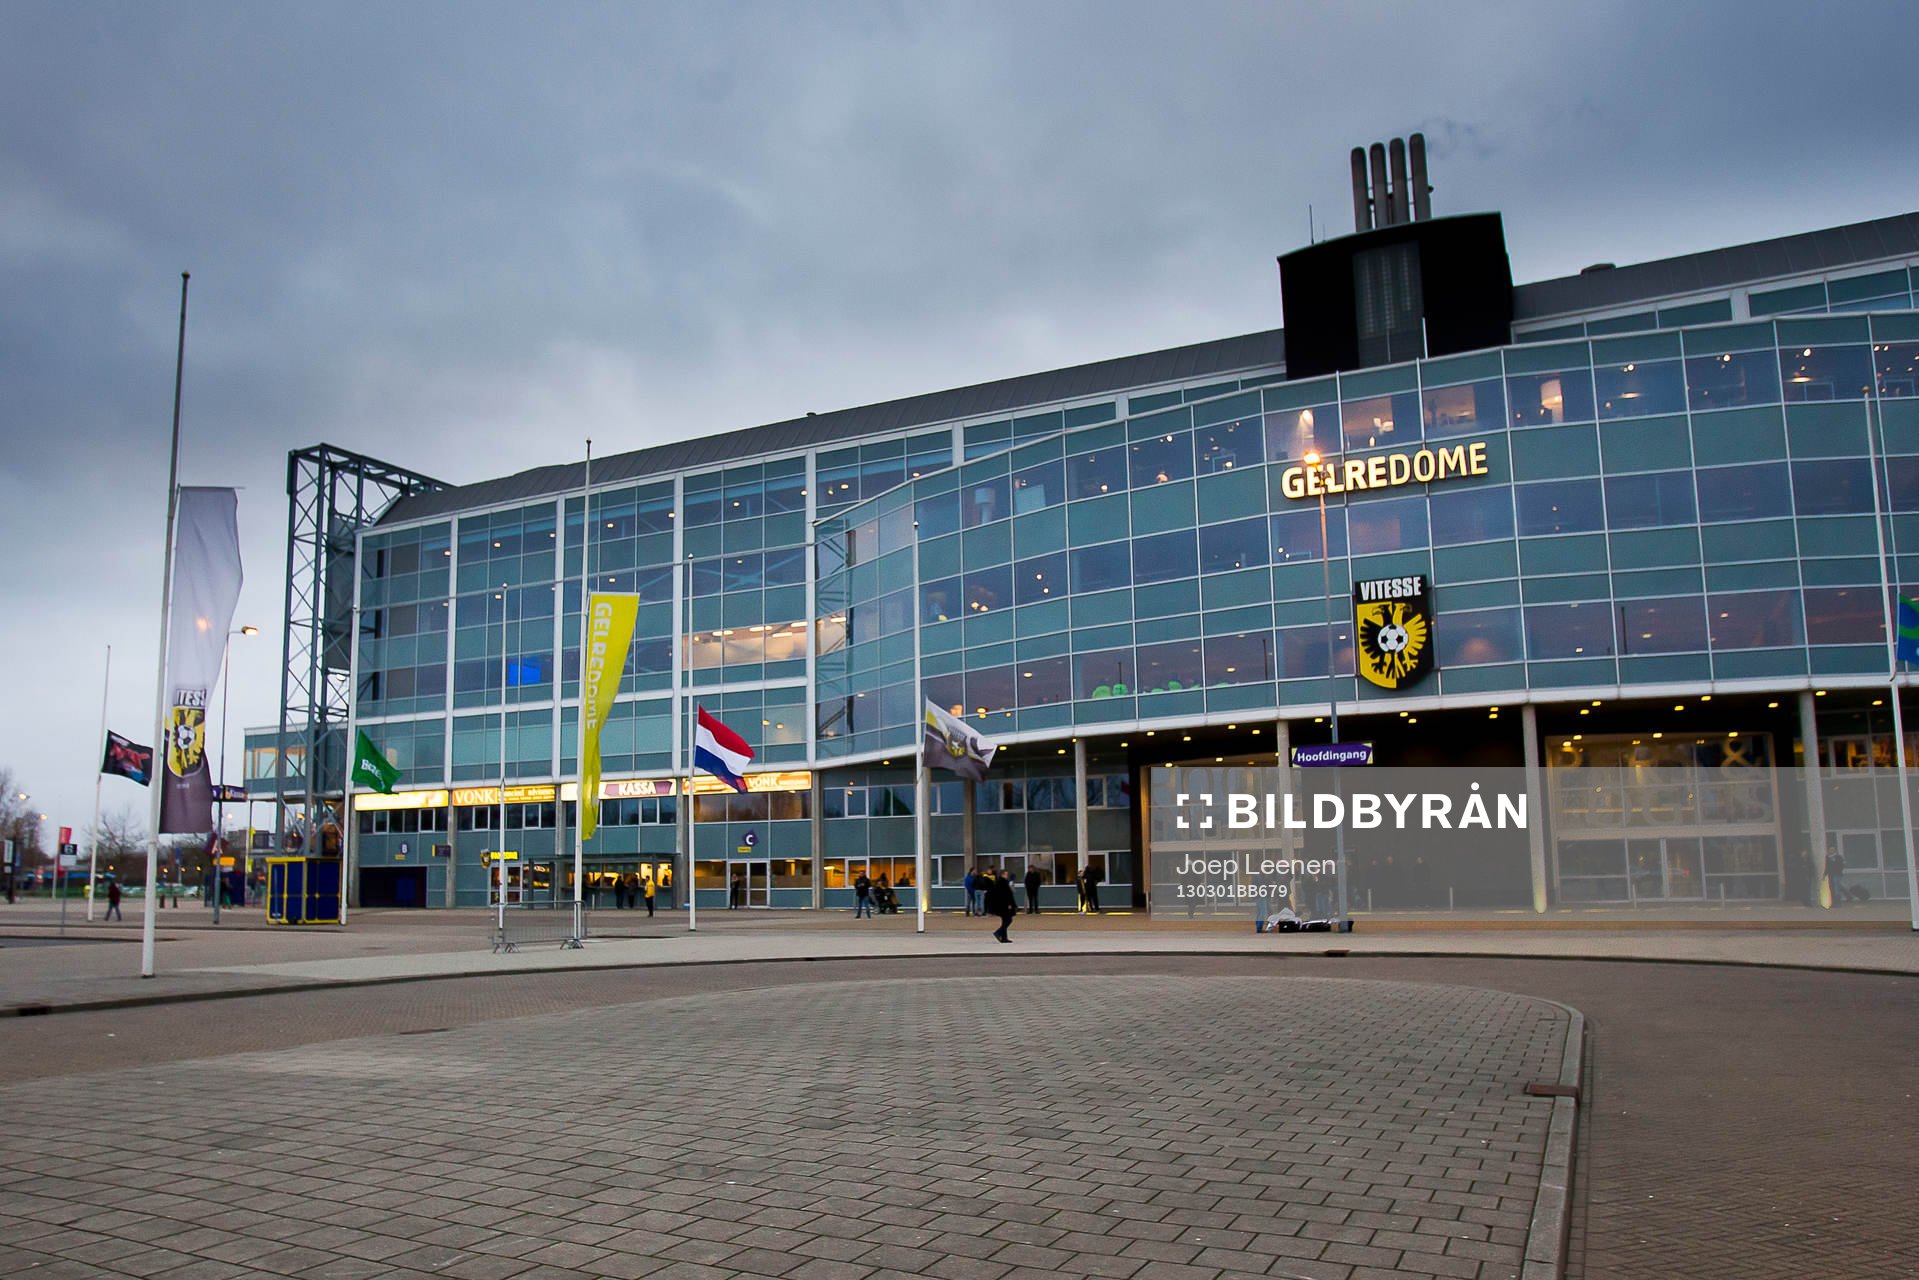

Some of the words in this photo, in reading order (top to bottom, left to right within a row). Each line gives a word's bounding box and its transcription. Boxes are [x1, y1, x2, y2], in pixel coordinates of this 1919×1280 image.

[1281, 441, 1489, 499] GELREDOME
[1360, 576, 1421, 602] VITESSE
[1297, 750, 1367, 762] Hoofdingang
[748, 777, 778, 787] VONK
[618, 783, 656, 796] KASSA
[454, 789, 495, 804] VONK
[745, 834, 754, 845] C
